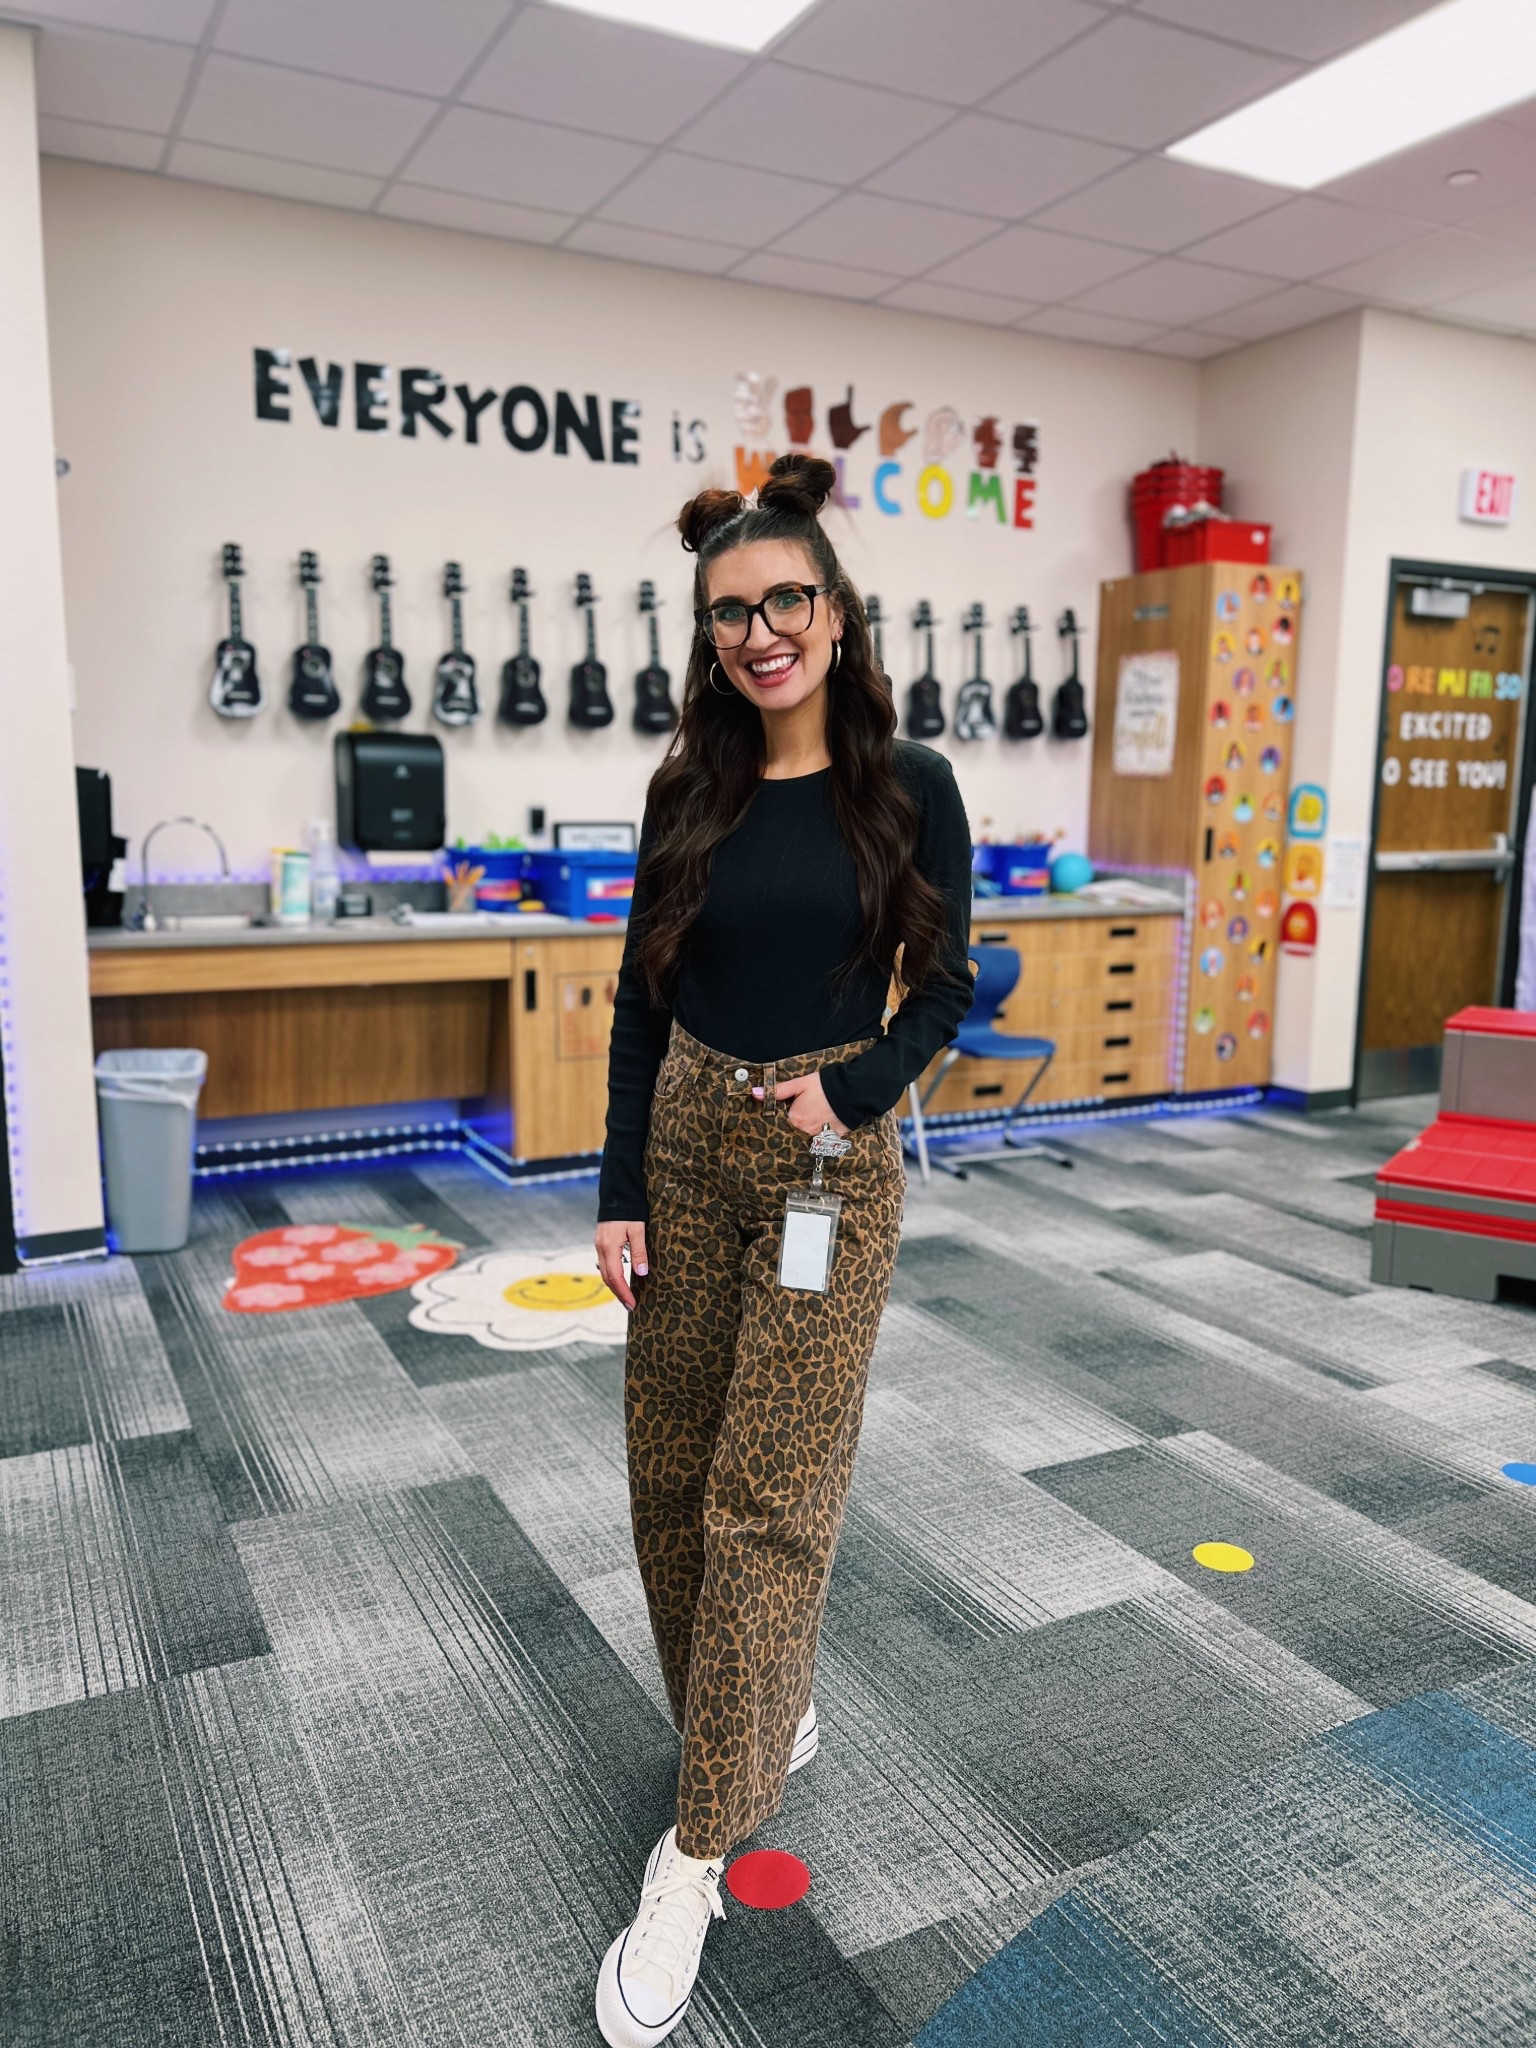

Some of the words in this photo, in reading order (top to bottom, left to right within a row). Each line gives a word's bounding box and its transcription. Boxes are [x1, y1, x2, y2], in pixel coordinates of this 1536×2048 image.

[254, 347, 641, 465] EVERYONE
[733, 444, 1038, 529] WLCOME
[1476, 471, 1515, 516] EXIT
[1405, 665, 1436, 695] RE
[1437, 667, 1467, 698] MI
[1468, 670, 1493, 699] FA
[1495, 672, 1521, 700] SO
[1400, 711, 1492, 742] EXCITED
[1408, 757, 1449, 788] SEE
[1456, 759, 1507, 790] YOU!
